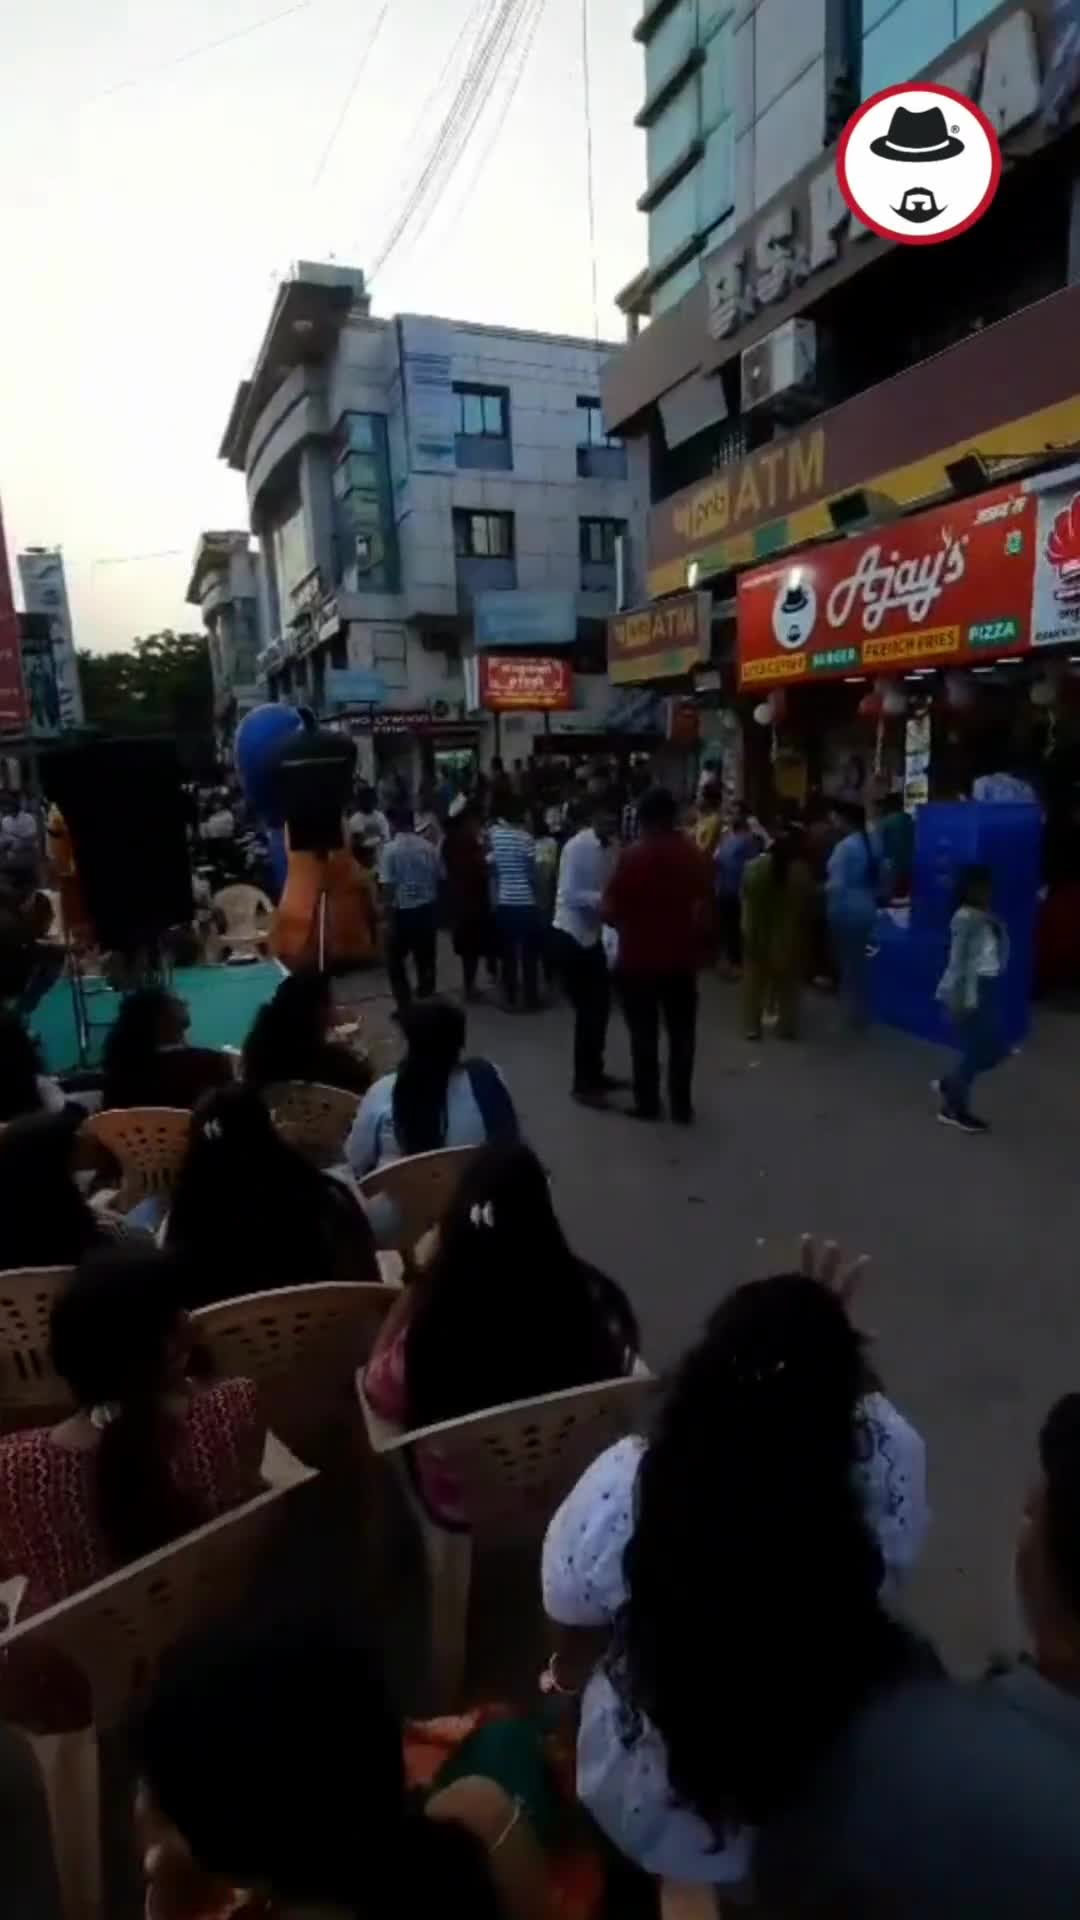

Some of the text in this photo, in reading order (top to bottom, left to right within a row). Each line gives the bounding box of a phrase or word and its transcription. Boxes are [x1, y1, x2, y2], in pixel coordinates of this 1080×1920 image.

[732, 428, 825, 521] ATM
[826, 528, 966, 633] Ajay's
[864, 630, 955, 658] FRENCH FRIES
[967, 621, 1016, 642] PIZZA
